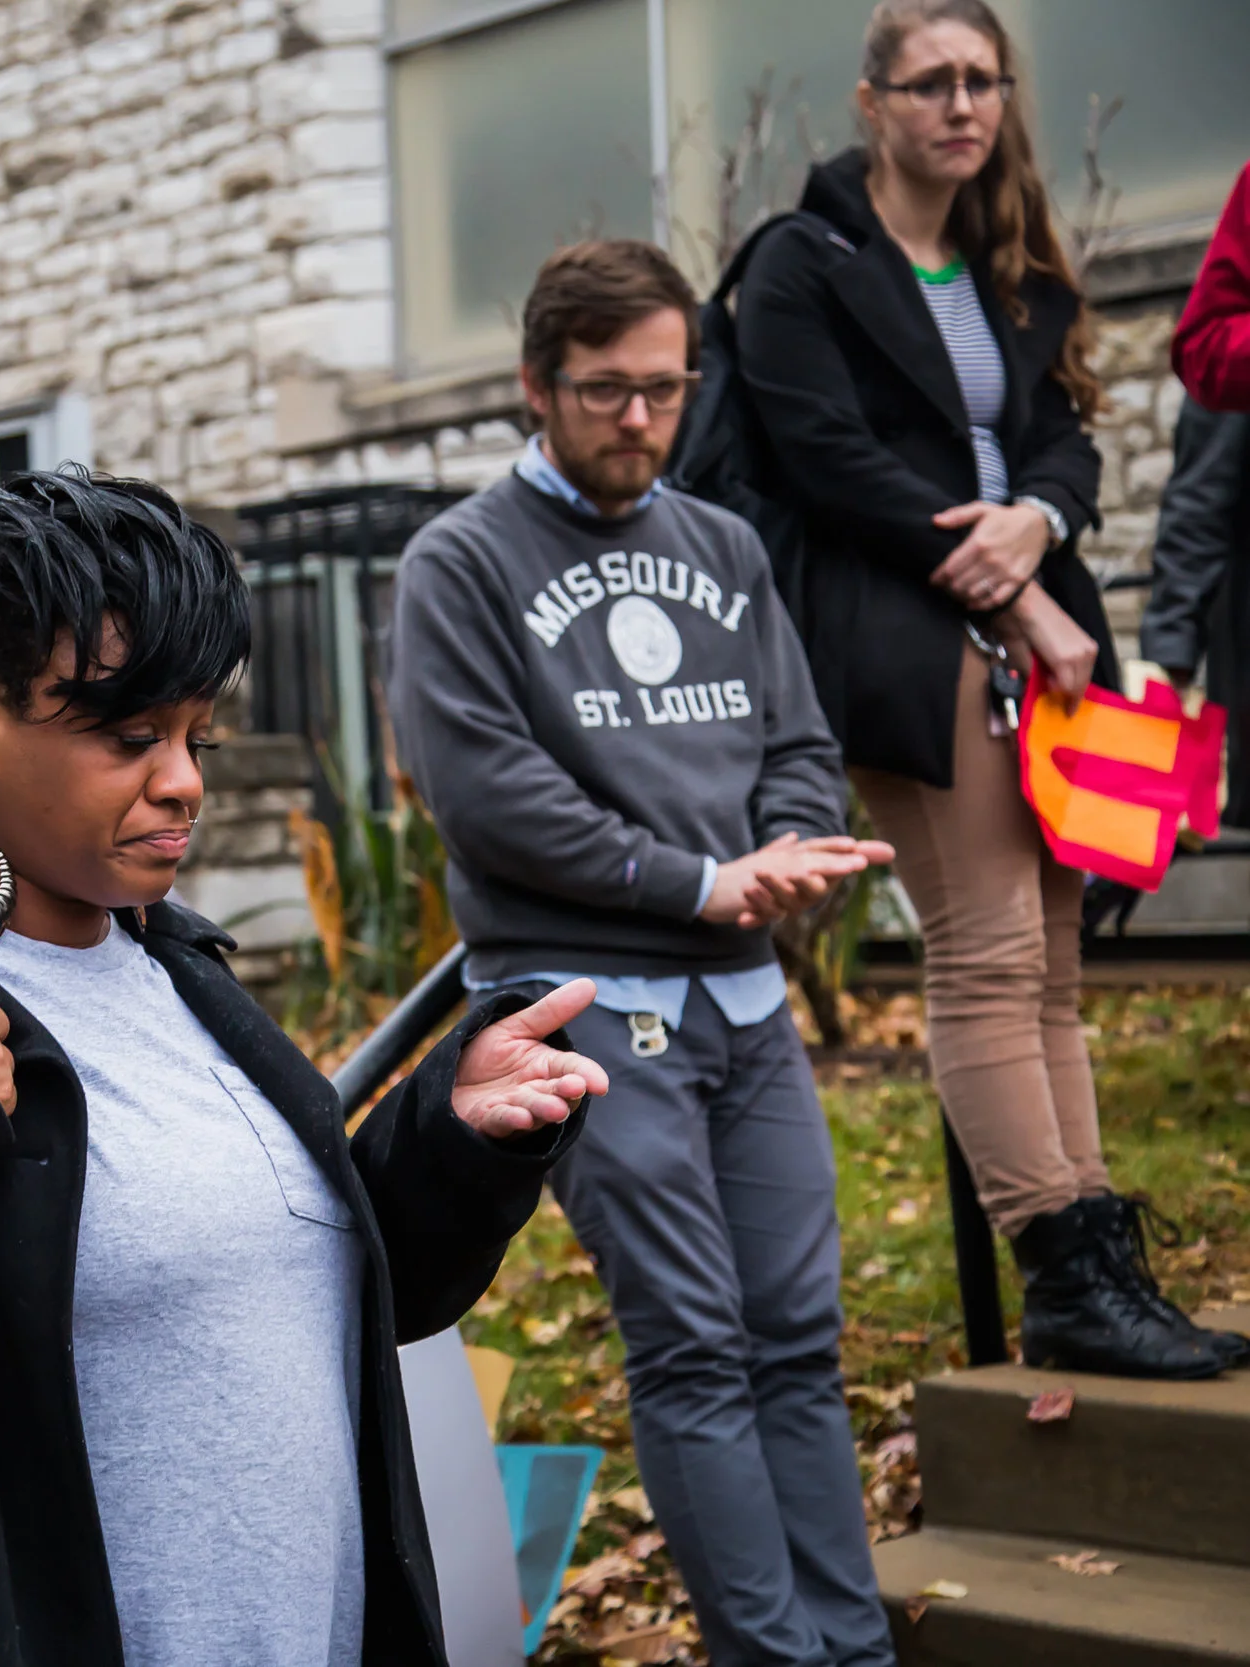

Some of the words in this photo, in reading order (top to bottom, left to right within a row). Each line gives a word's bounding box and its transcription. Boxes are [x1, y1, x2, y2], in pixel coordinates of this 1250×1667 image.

[523, 551, 750, 648] MISSOURI
[573, 689, 632, 728] ST.
[637, 679, 752, 725] LOUIS
